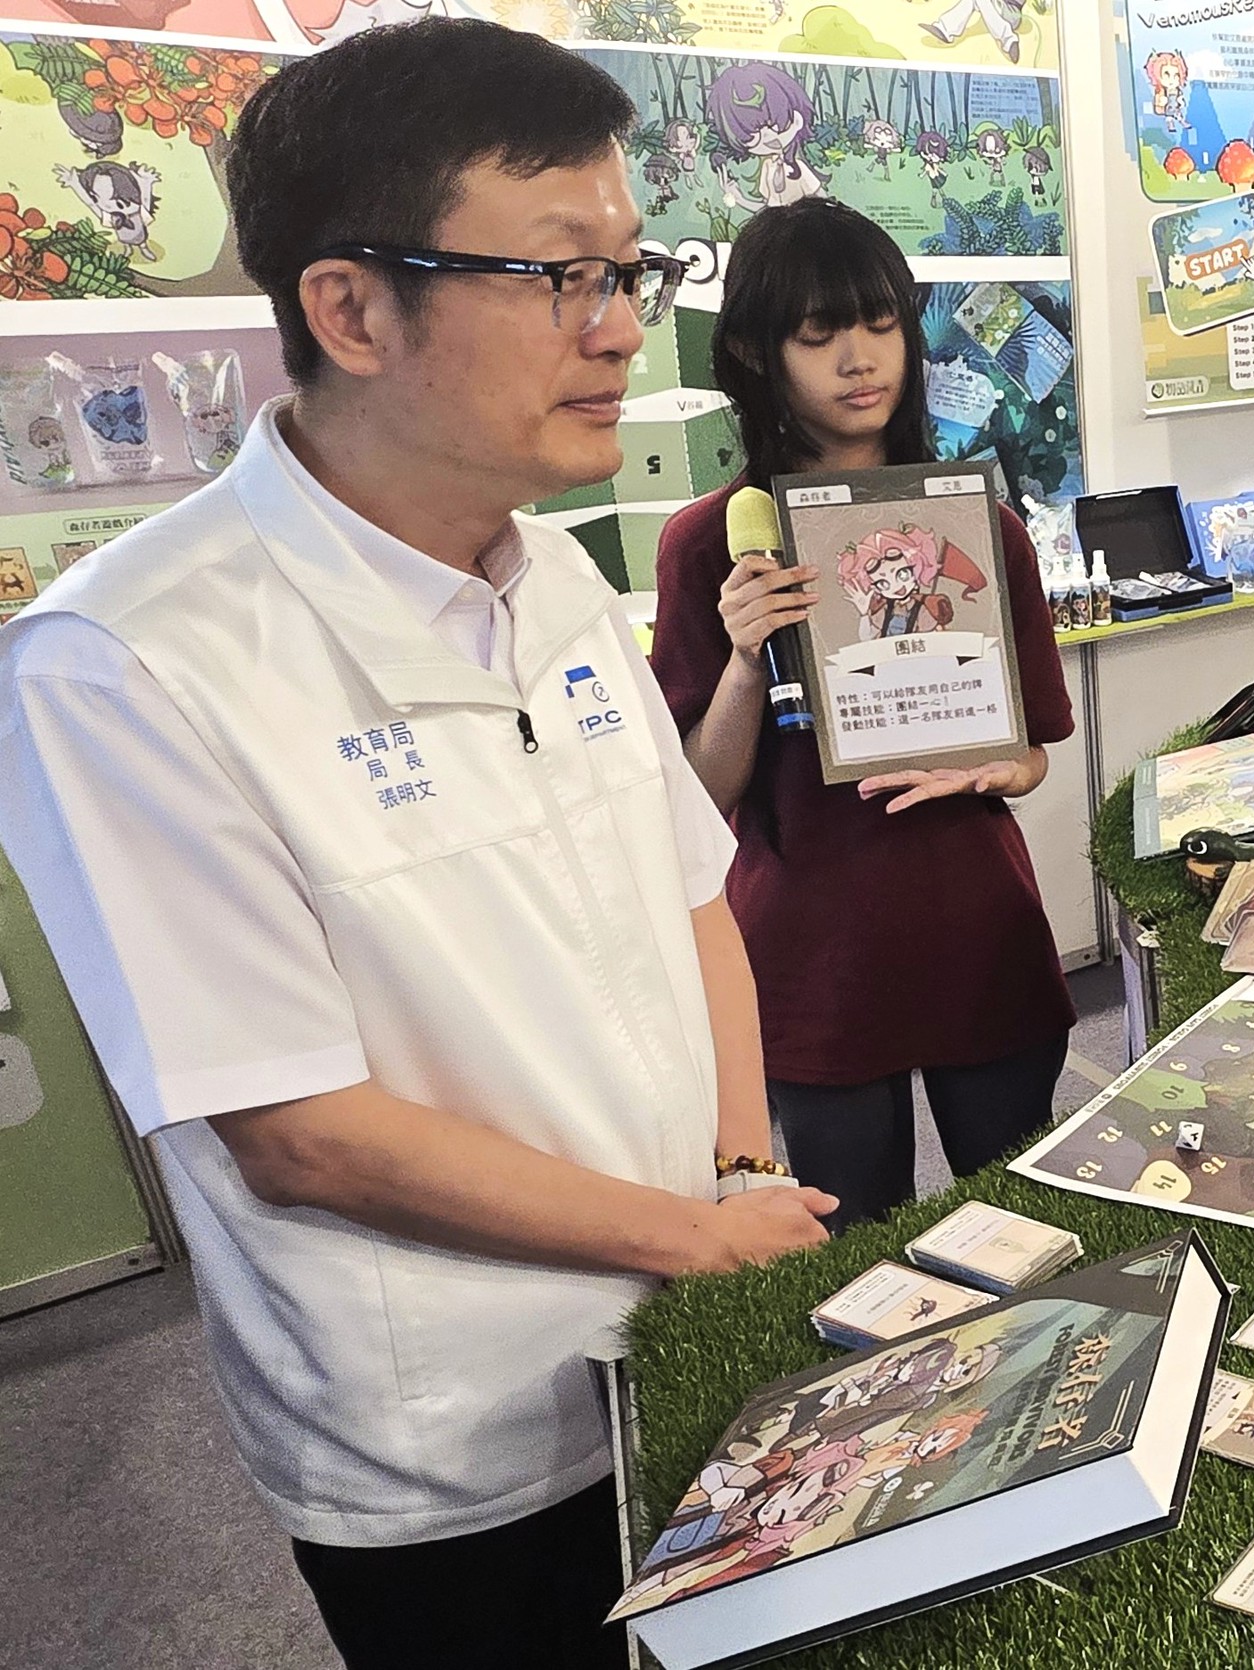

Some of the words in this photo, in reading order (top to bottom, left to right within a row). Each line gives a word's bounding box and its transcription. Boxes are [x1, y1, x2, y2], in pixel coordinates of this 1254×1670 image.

[1189, 243, 1245, 277] START
[894, 638, 927, 656] 團結
[337, 720, 416, 762] 教育局
[366, 758, 389, 782] 局
[404, 749, 426, 771] 長
[375, 778, 438, 810] 張明文
[1221, 1043, 1241, 1053] 8
[1161, 1085, 1184, 1100] 10
[1097, 1126, 1123, 1143] 12
[1076, 1161, 1102, 1178] 13
[1200, 1156, 1227, 1175] 15
[1153, 1174, 1177, 1189] 14
[1044, 1322, 1075, 1374] FOREST
[1035, 1331, 1112, 1451] 森存者
